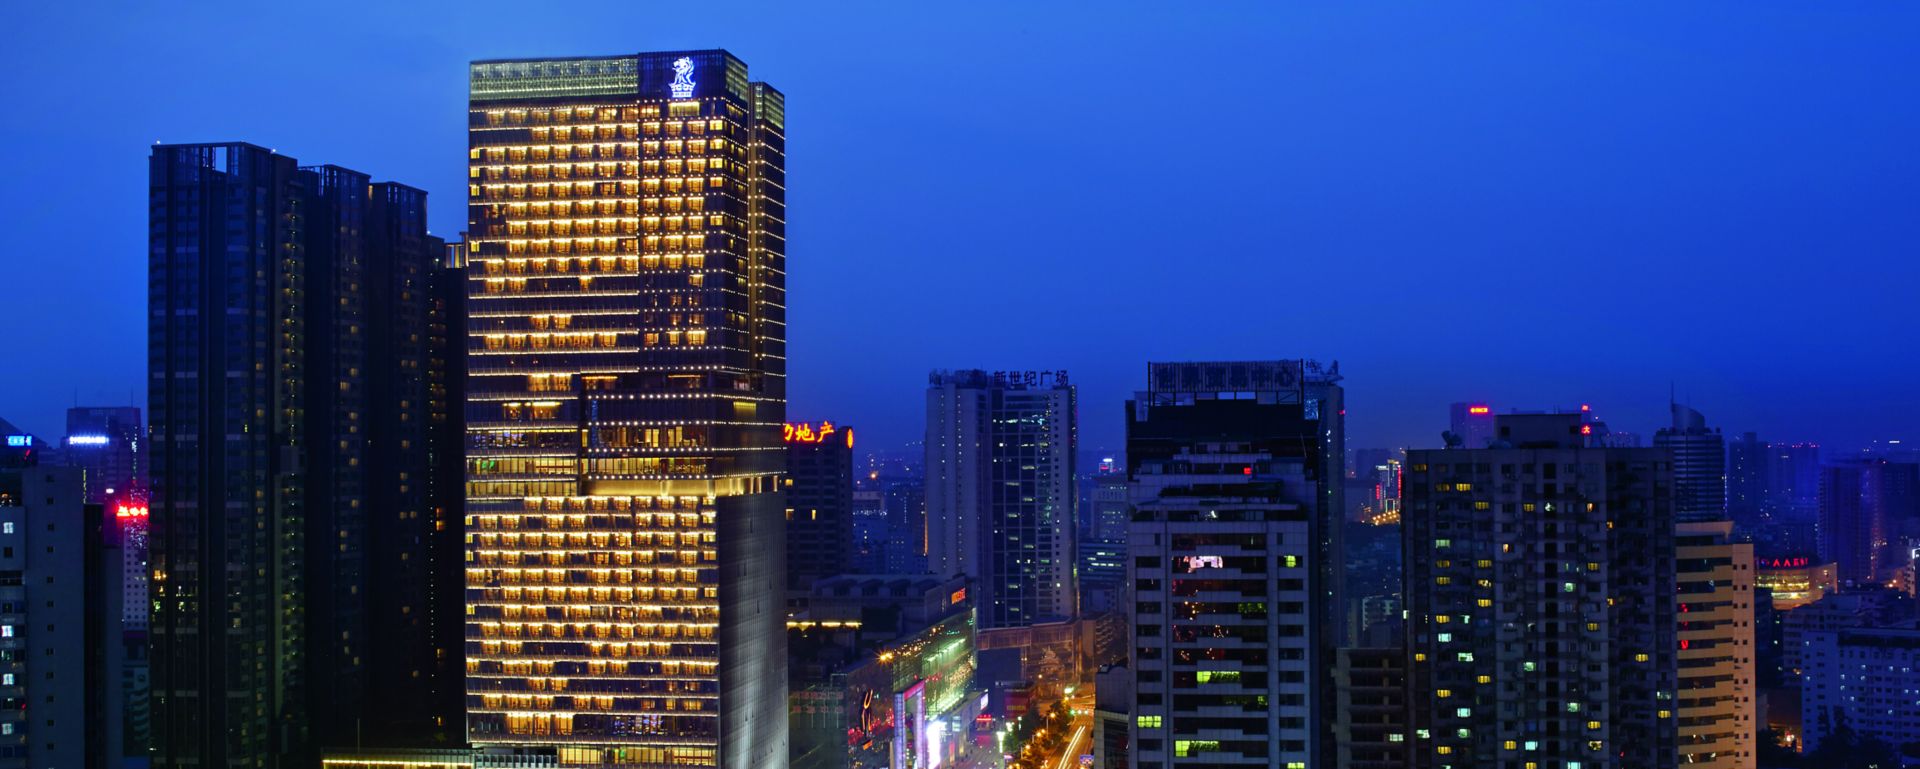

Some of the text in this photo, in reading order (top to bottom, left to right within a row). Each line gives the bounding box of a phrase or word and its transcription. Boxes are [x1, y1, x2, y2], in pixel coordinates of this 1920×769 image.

[993, 369, 1069, 386] 新世纪广场
